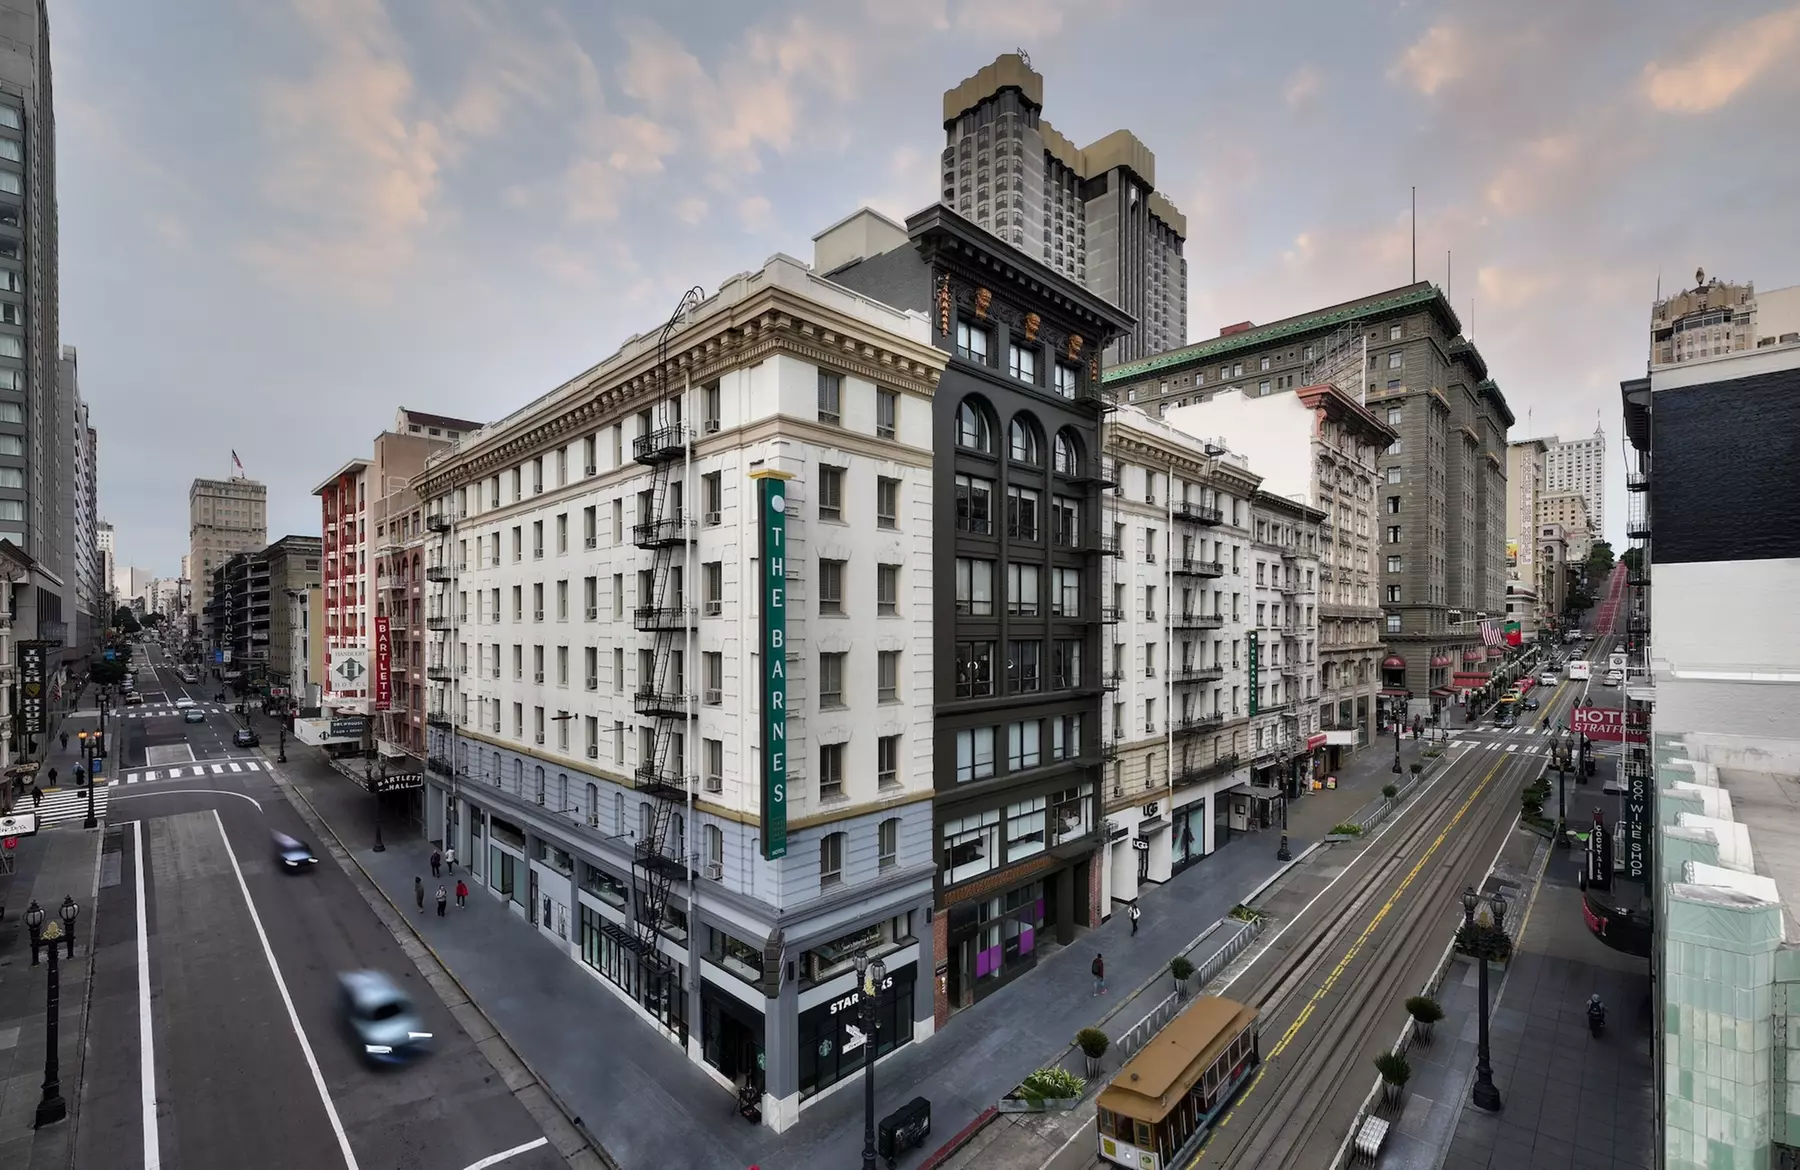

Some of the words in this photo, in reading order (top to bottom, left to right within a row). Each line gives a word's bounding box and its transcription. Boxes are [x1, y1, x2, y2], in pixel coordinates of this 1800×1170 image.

[772, 527, 783, 607] THE
[225, 584, 233, 640] PARKING
[379, 624, 388, 699] BARTLETT
[772, 629, 784, 802] BARNES
[1574, 709, 1643, 725] HOTEL
[1574, 722, 1643, 736] STRATF
[377, 775, 421, 787] BARTLETT
[389, 782, 409, 790] HALL
[1142, 802, 1158, 817] UGG
[1630, 803, 1644, 839] WINE
[1133, 839, 1148, 850] UGG
[1595, 824, 1603, 881] COCKTAILS
[1630, 842, 1643, 877] SHOP
[830, 977, 893, 1015] STARKS
